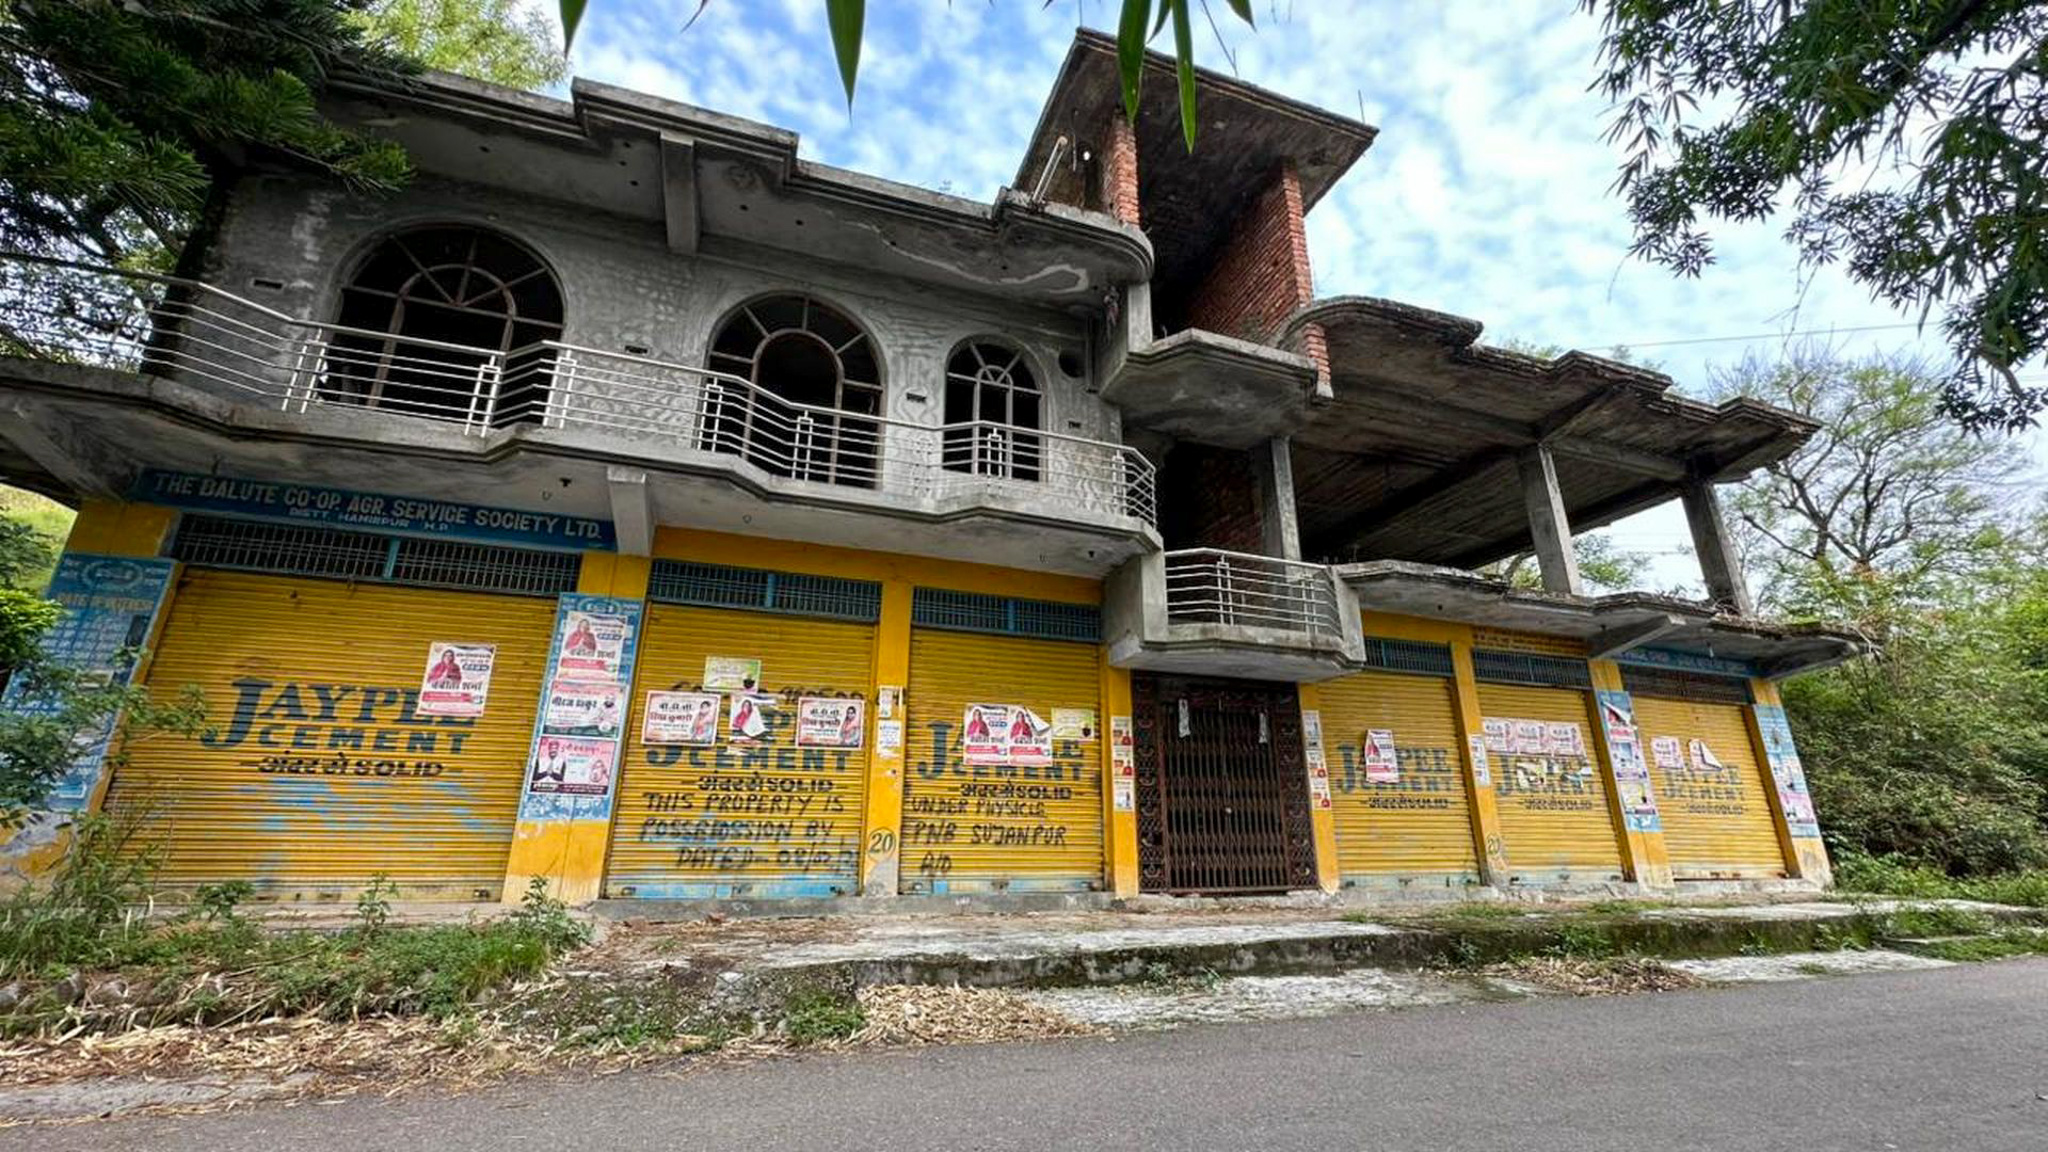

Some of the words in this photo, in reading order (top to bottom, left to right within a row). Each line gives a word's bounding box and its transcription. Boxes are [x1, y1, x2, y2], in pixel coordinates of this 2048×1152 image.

[155, 473, 194, 494] THE
[391, 499, 470, 525] SERVICE
[474, 508, 560, 534] SOCIETY
[338, 513, 410, 528] HAMIRPUR
[256, 723, 472, 754] CEMENT
[354, 760, 444, 777] SOLID
[769, 778, 834, 793] SOLID
[1016, 784, 1072, 800] SOLID
[642, 791, 695, 812] THIS
[705, 793, 814, 816] PROPERTY
[823, 795, 845, 812] IS
[911, 797, 968, 814] UNDER
[806, 819, 835, 838] BY
[913, 820, 957, 844] PNB
[869, 832, 894, 853] 20
